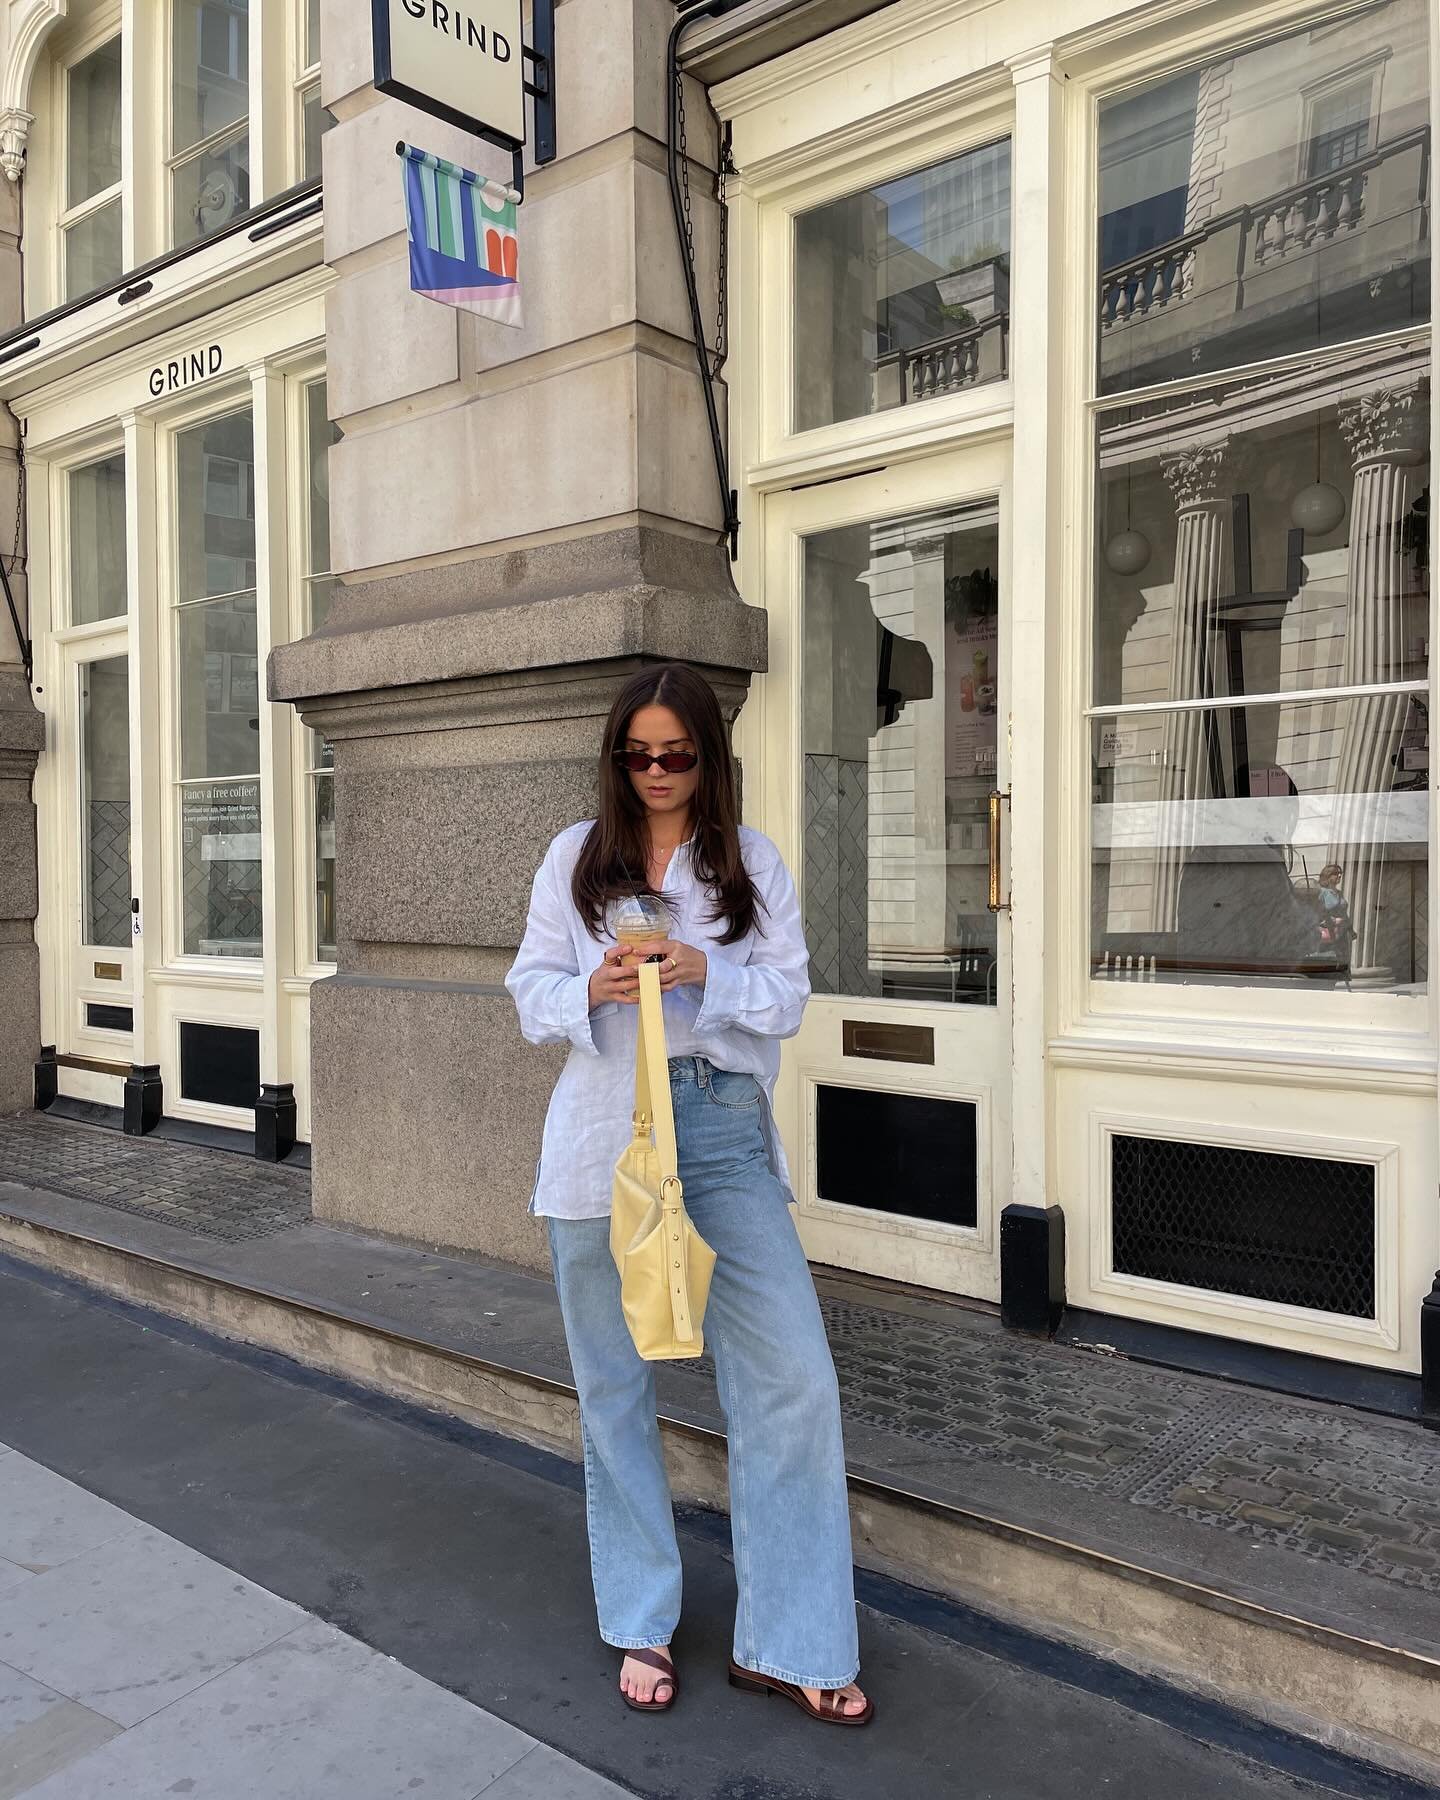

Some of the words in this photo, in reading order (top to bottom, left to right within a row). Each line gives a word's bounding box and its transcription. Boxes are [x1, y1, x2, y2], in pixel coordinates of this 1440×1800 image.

[402, 0, 511, 63] GRIND
[149, 344, 222, 396] GRIND
[184, 790, 205, 802] Fancy
[207, 790, 211, 798] a
[213, 787, 228, 798] free
[229, 785, 257, 797] coffee?
